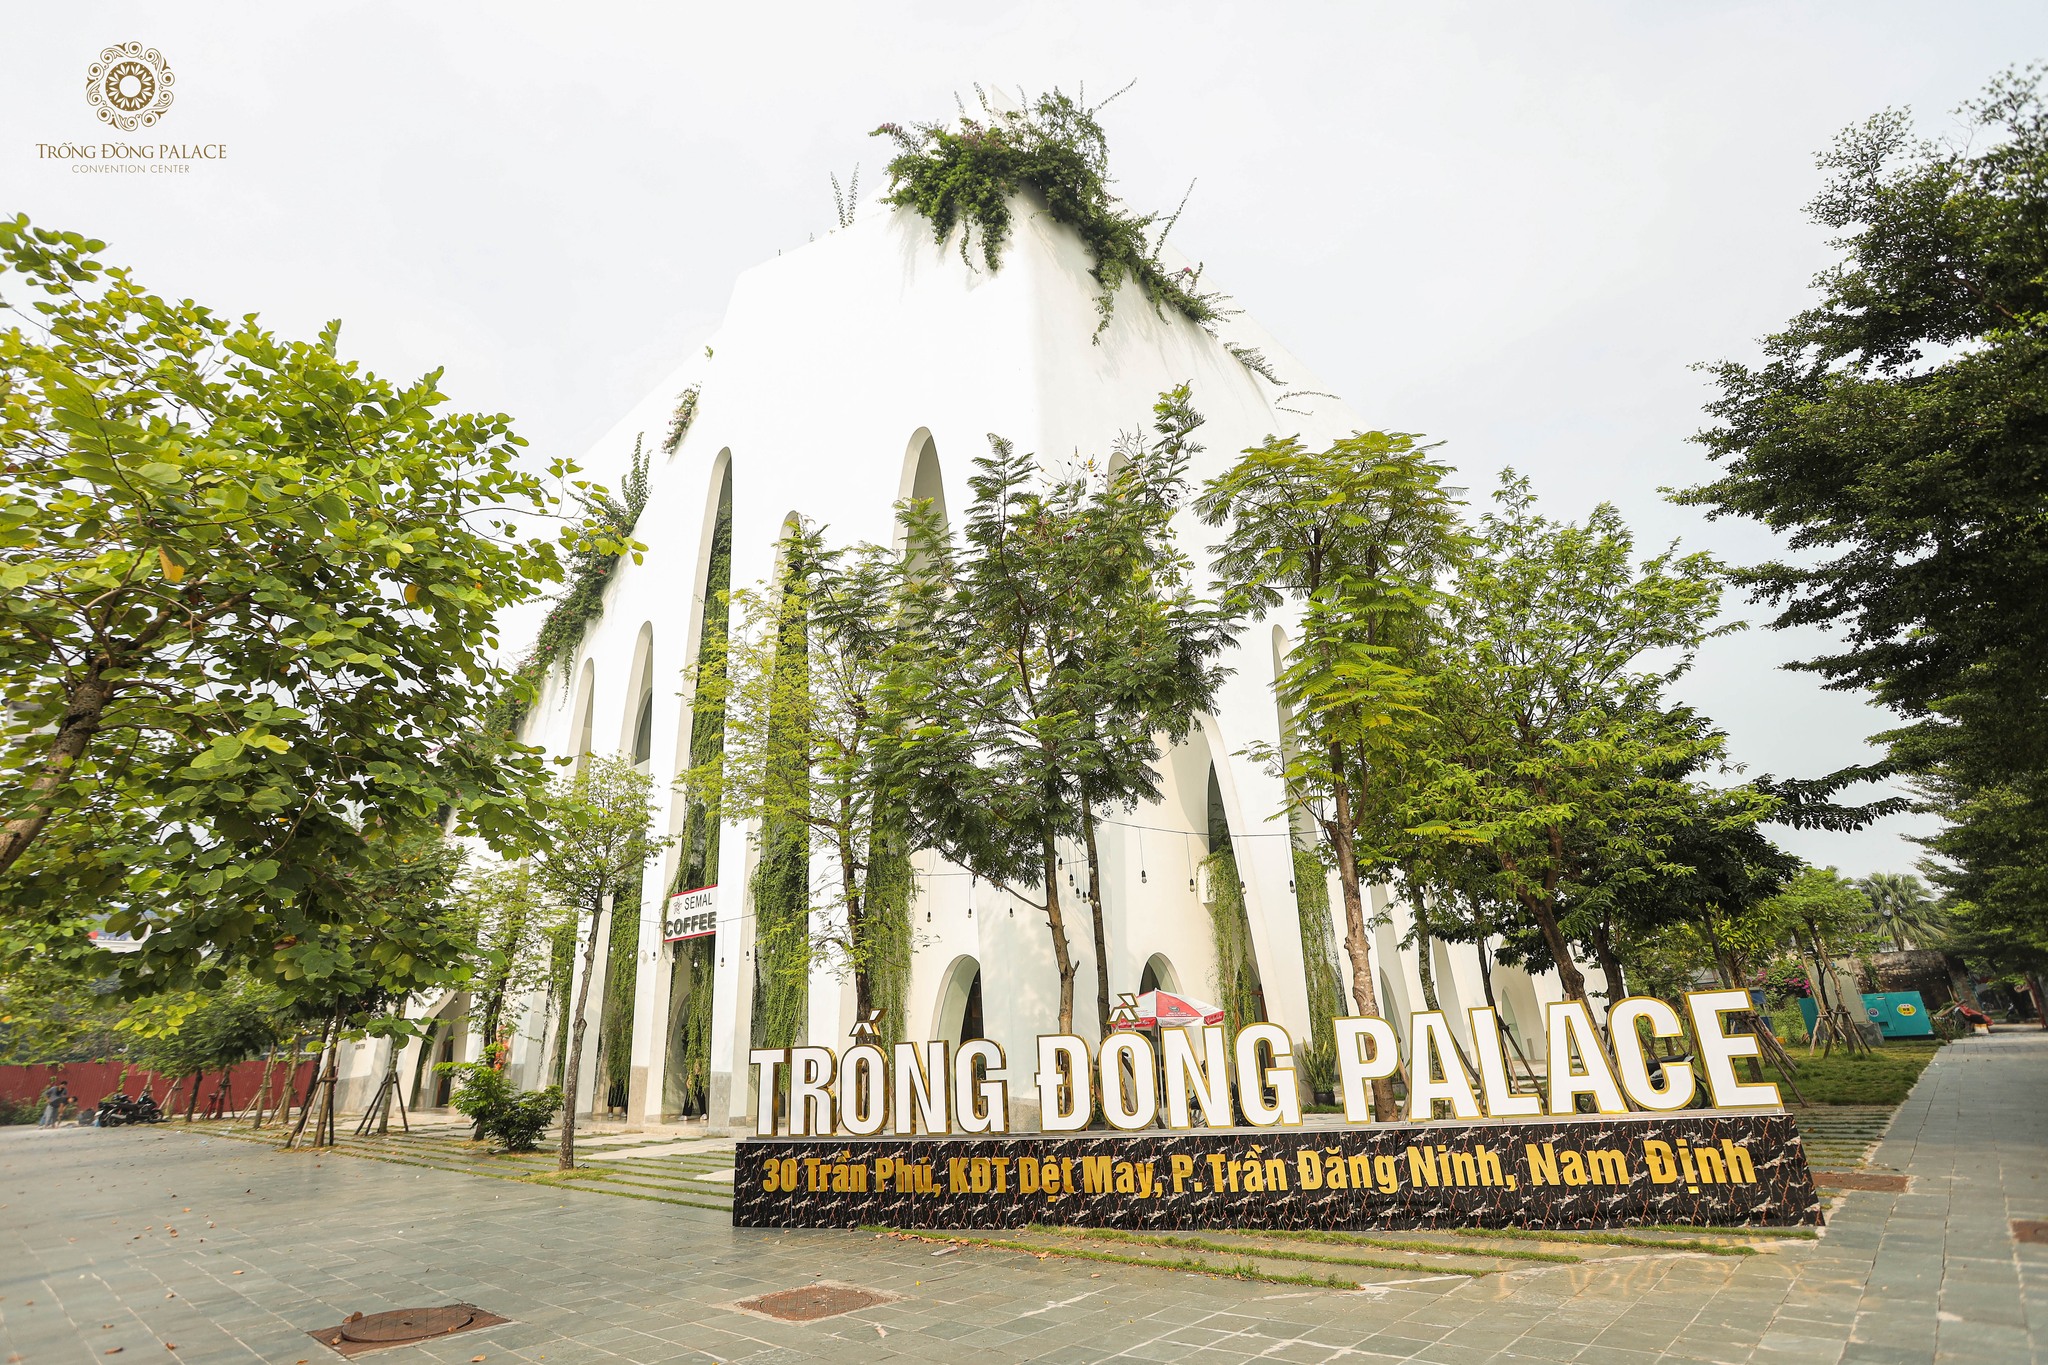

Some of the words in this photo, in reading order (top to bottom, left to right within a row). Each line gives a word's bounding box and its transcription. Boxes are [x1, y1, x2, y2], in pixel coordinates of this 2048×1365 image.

[665, 911, 718, 938] COFFEE
[684, 892, 713, 911] SEMAL
[749, 1008, 1009, 1137] TRỐNG
[1035, 993, 1303, 1132] ĐỒNG
[1332, 989, 1785, 1124] PALACE
[762, 1157, 798, 1193] 30
[804, 1150, 868, 1193] Trần
[875, 1156, 942, 1198] Phú,
[949, 1157, 1010, 1194] KĐT
[1018, 1155, 1075, 1203] Dệt
[1082, 1155, 1163, 1199] May,
[1297, 1146, 1399, 1195] Đăng
[1406, 1144, 1516, 1192] Ninh,
[1525, 1143, 1630, 1187] Nam
[1643, 1138, 1758, 1194] Định
